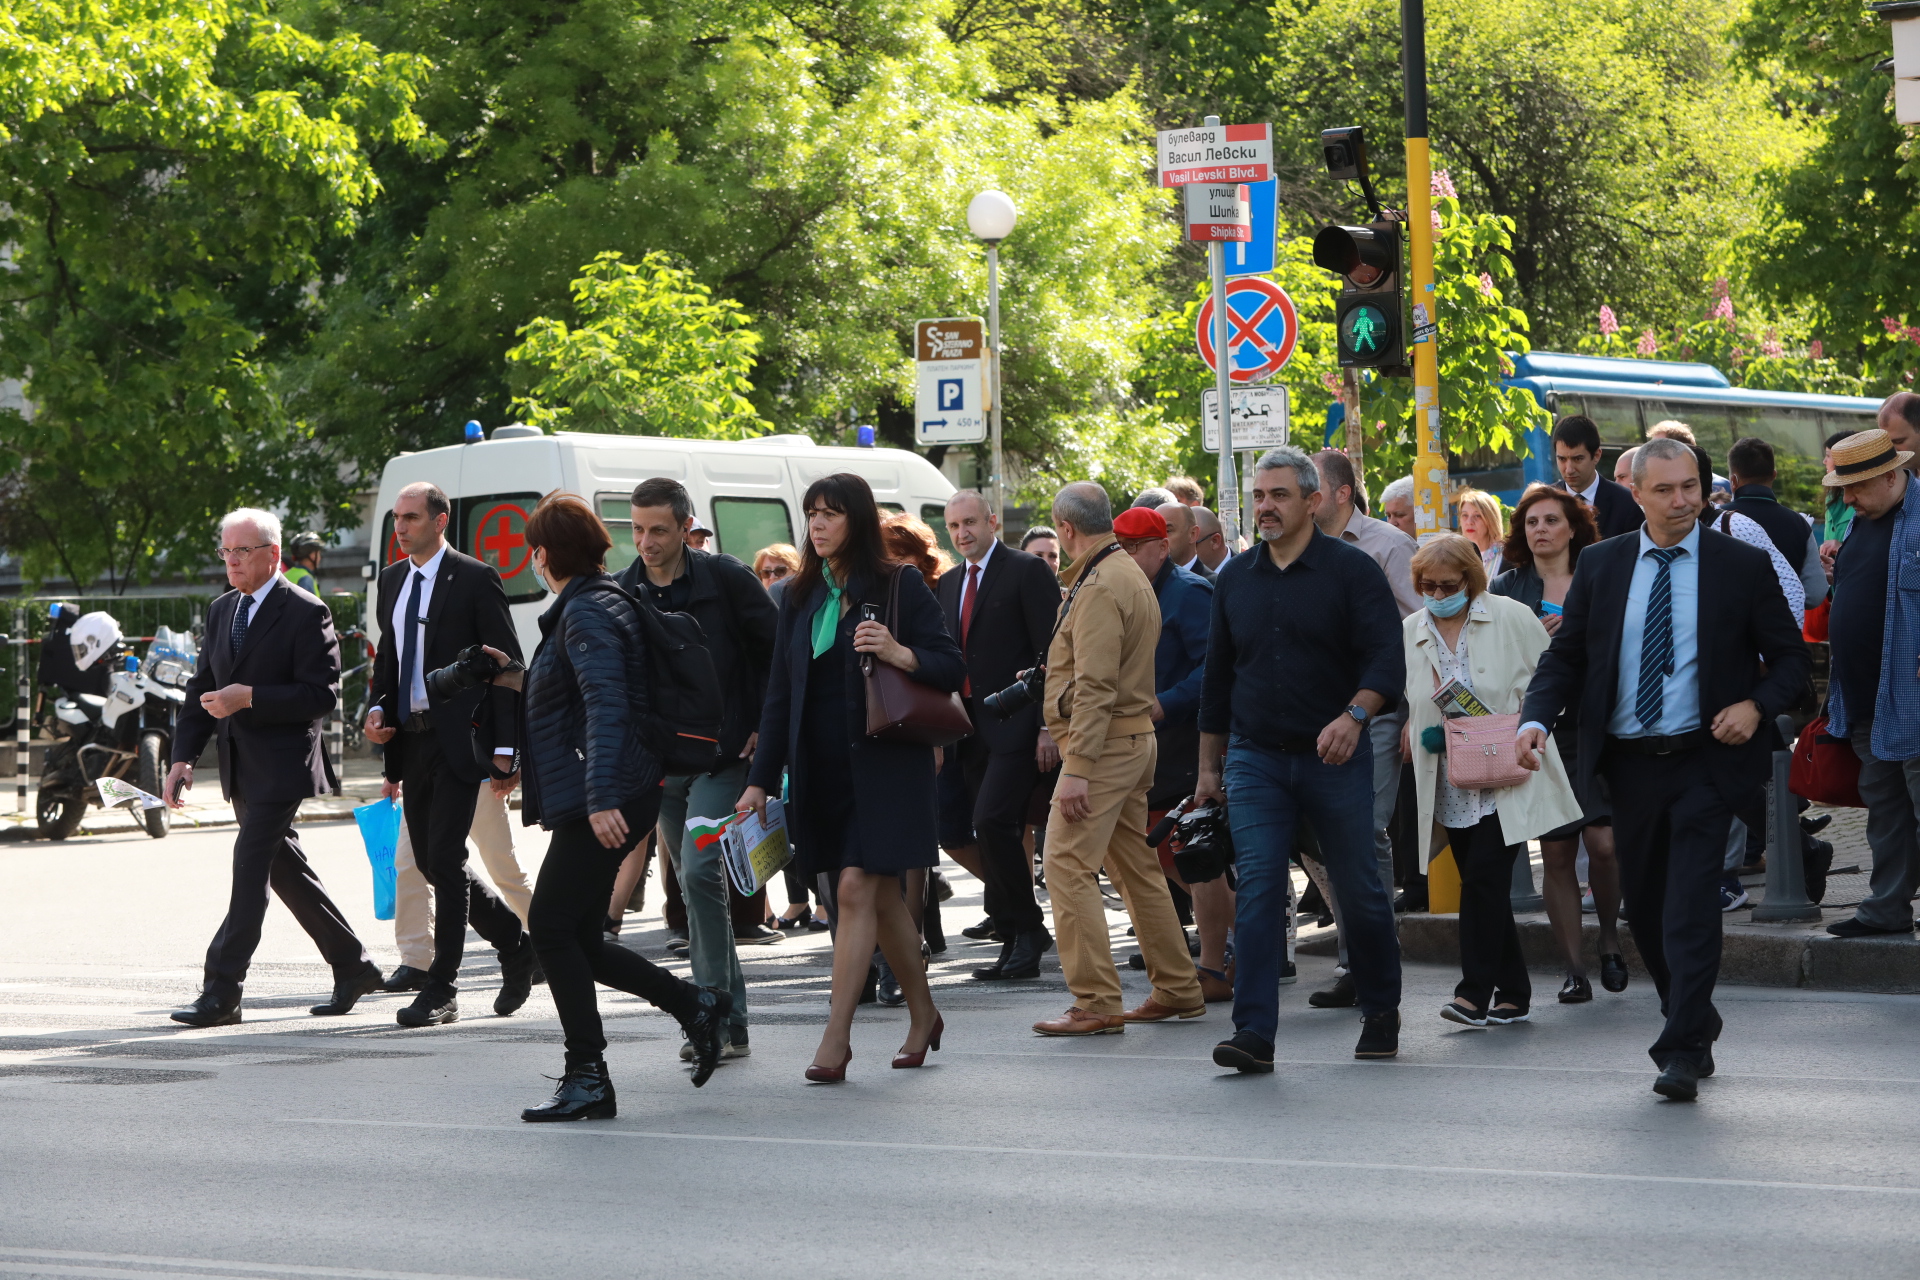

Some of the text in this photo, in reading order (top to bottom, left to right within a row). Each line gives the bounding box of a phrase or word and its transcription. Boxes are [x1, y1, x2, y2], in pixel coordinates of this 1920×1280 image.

[1168, 130, 1216, 147] булевард
[1168, 146, 1257, 164] Васил Левски
[1169, 167, 1258, 184] Vasil Levski Blvd.
[1209, 187, 1236, 200] улица
[1210, 204, 1240, 218] Шипка
[1210, 226, 1236, 240] Shipka
[944, 332, 960, 340] SAN
[957, 418, 972, 427] 450
[1455, 690, 1473, 707] НА
